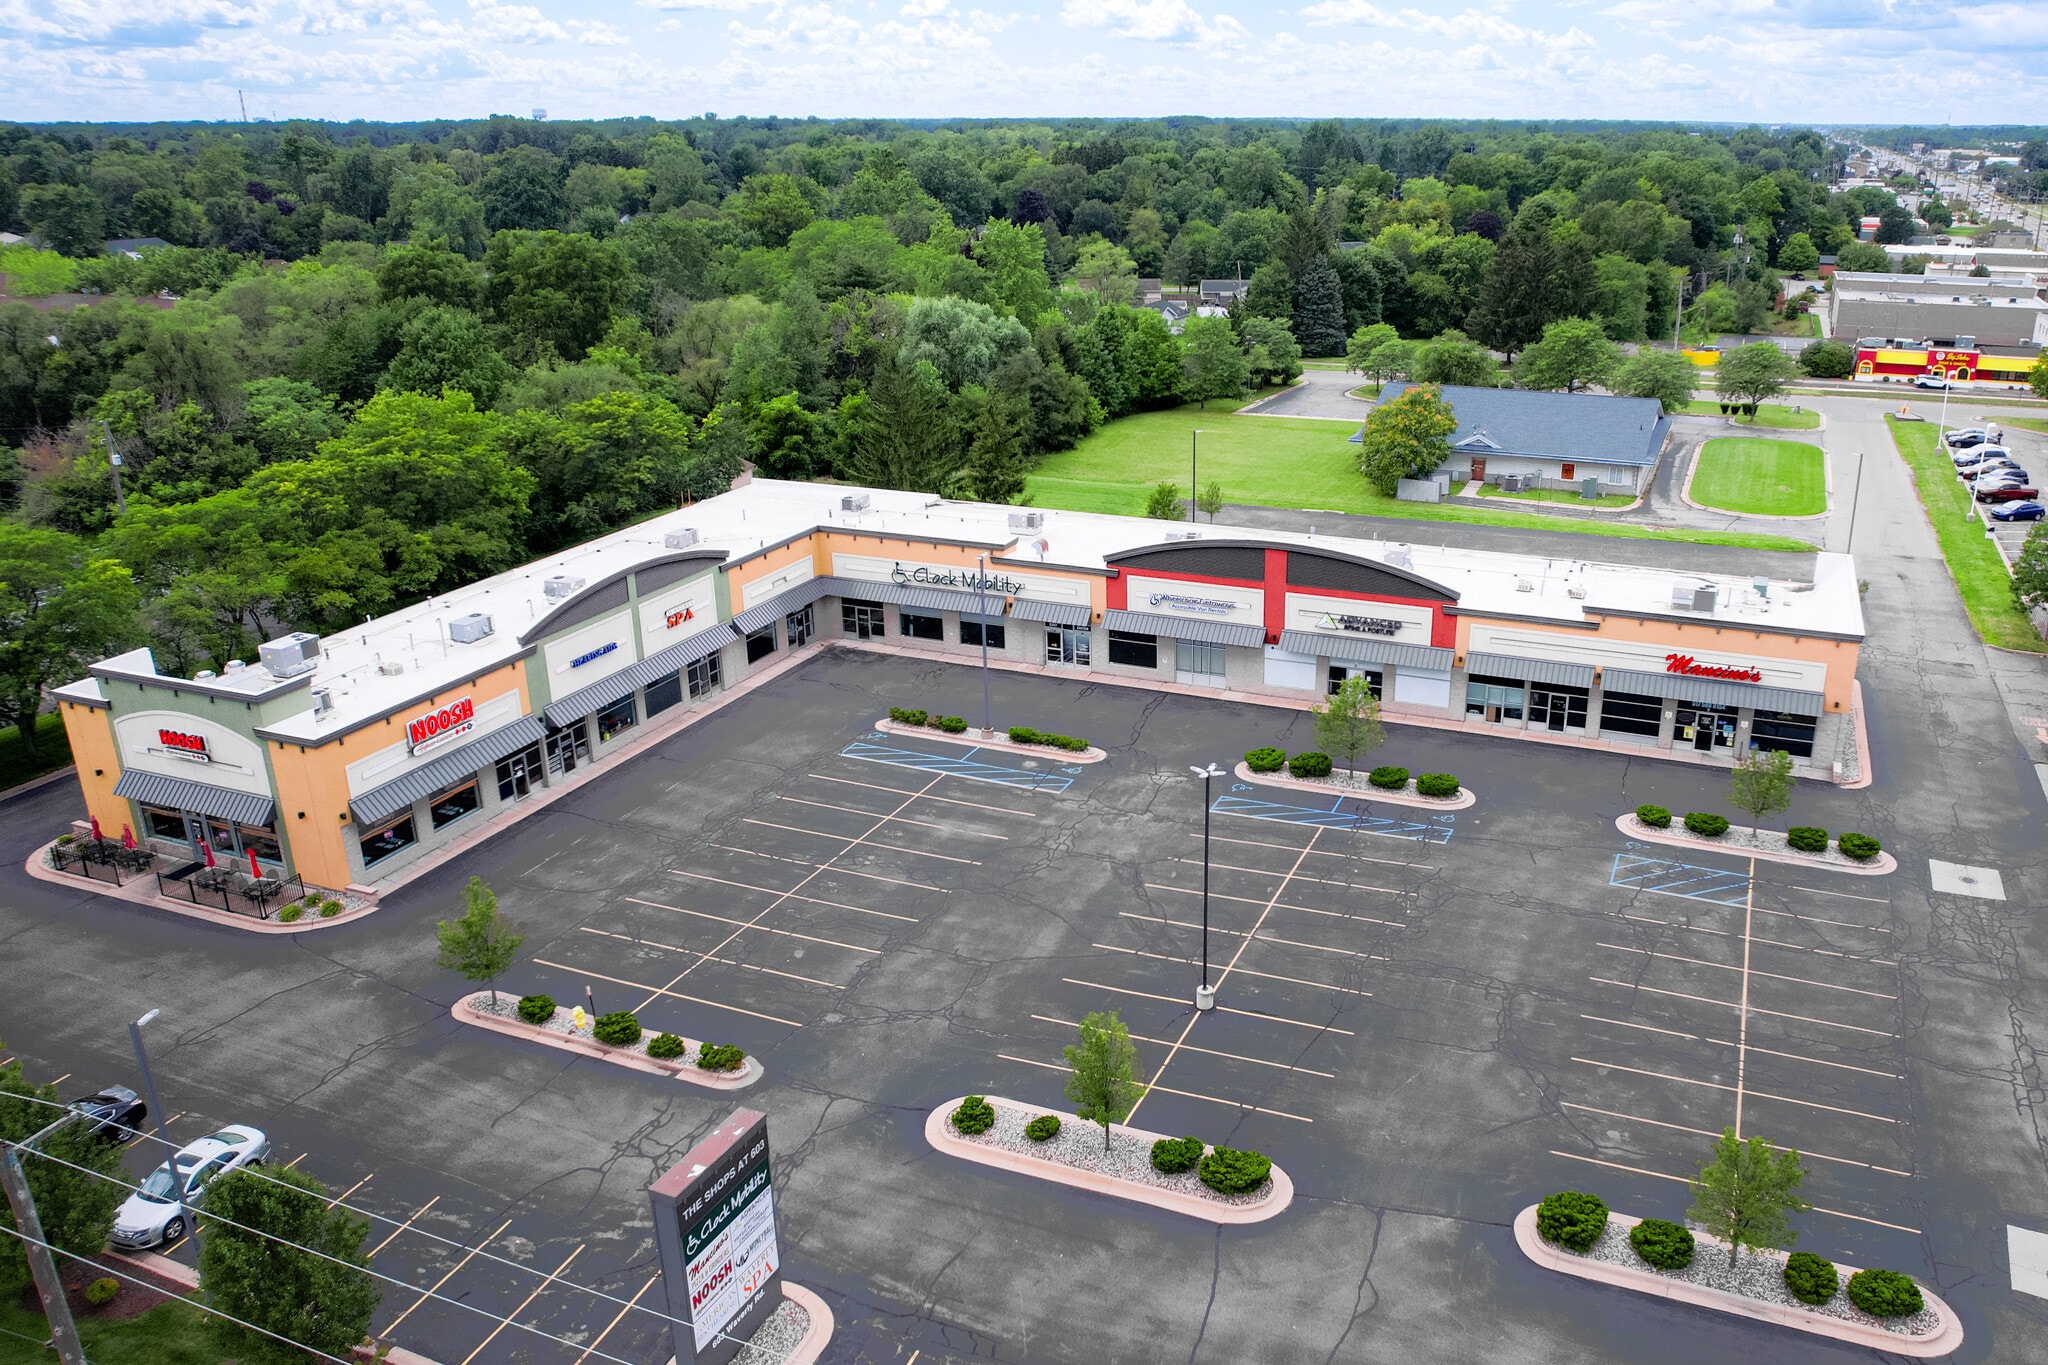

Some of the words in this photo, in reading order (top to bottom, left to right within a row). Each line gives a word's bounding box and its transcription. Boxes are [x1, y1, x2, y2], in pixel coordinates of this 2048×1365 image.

[913, 567, 958, 587] Clock
[962, 571, 1021, 596] Mobility
[667, 607, 694, 629] SPA
[1338, 614, 1402, 630] ADVANCED
[1666, 653, 1761, 683] Mancino's
[159, 729, 205, 751] NOOSH
[410, 699, 474, 744] NOOSH
[682, 1198, 703, 1221] THE
[704, 1167, 736, 1202] SHOPS
[737, 1153, 749, 1172] AT
[750, 1139, 765, 1159] 603
[700, 1204, 731, 1239] Clock
[730, 1169, 767, 1210] Mobility
[688, 1231, 729, 1281] Mancino's
[692, 1259, 732, 1309] NOOSH
[743, 1261, 773, 1299] SPA
[712, 1331, 725, 1348] 603
[726, 1301, 754, 1333] Waverly
[754, 1288, 766, 1304] Rd.
